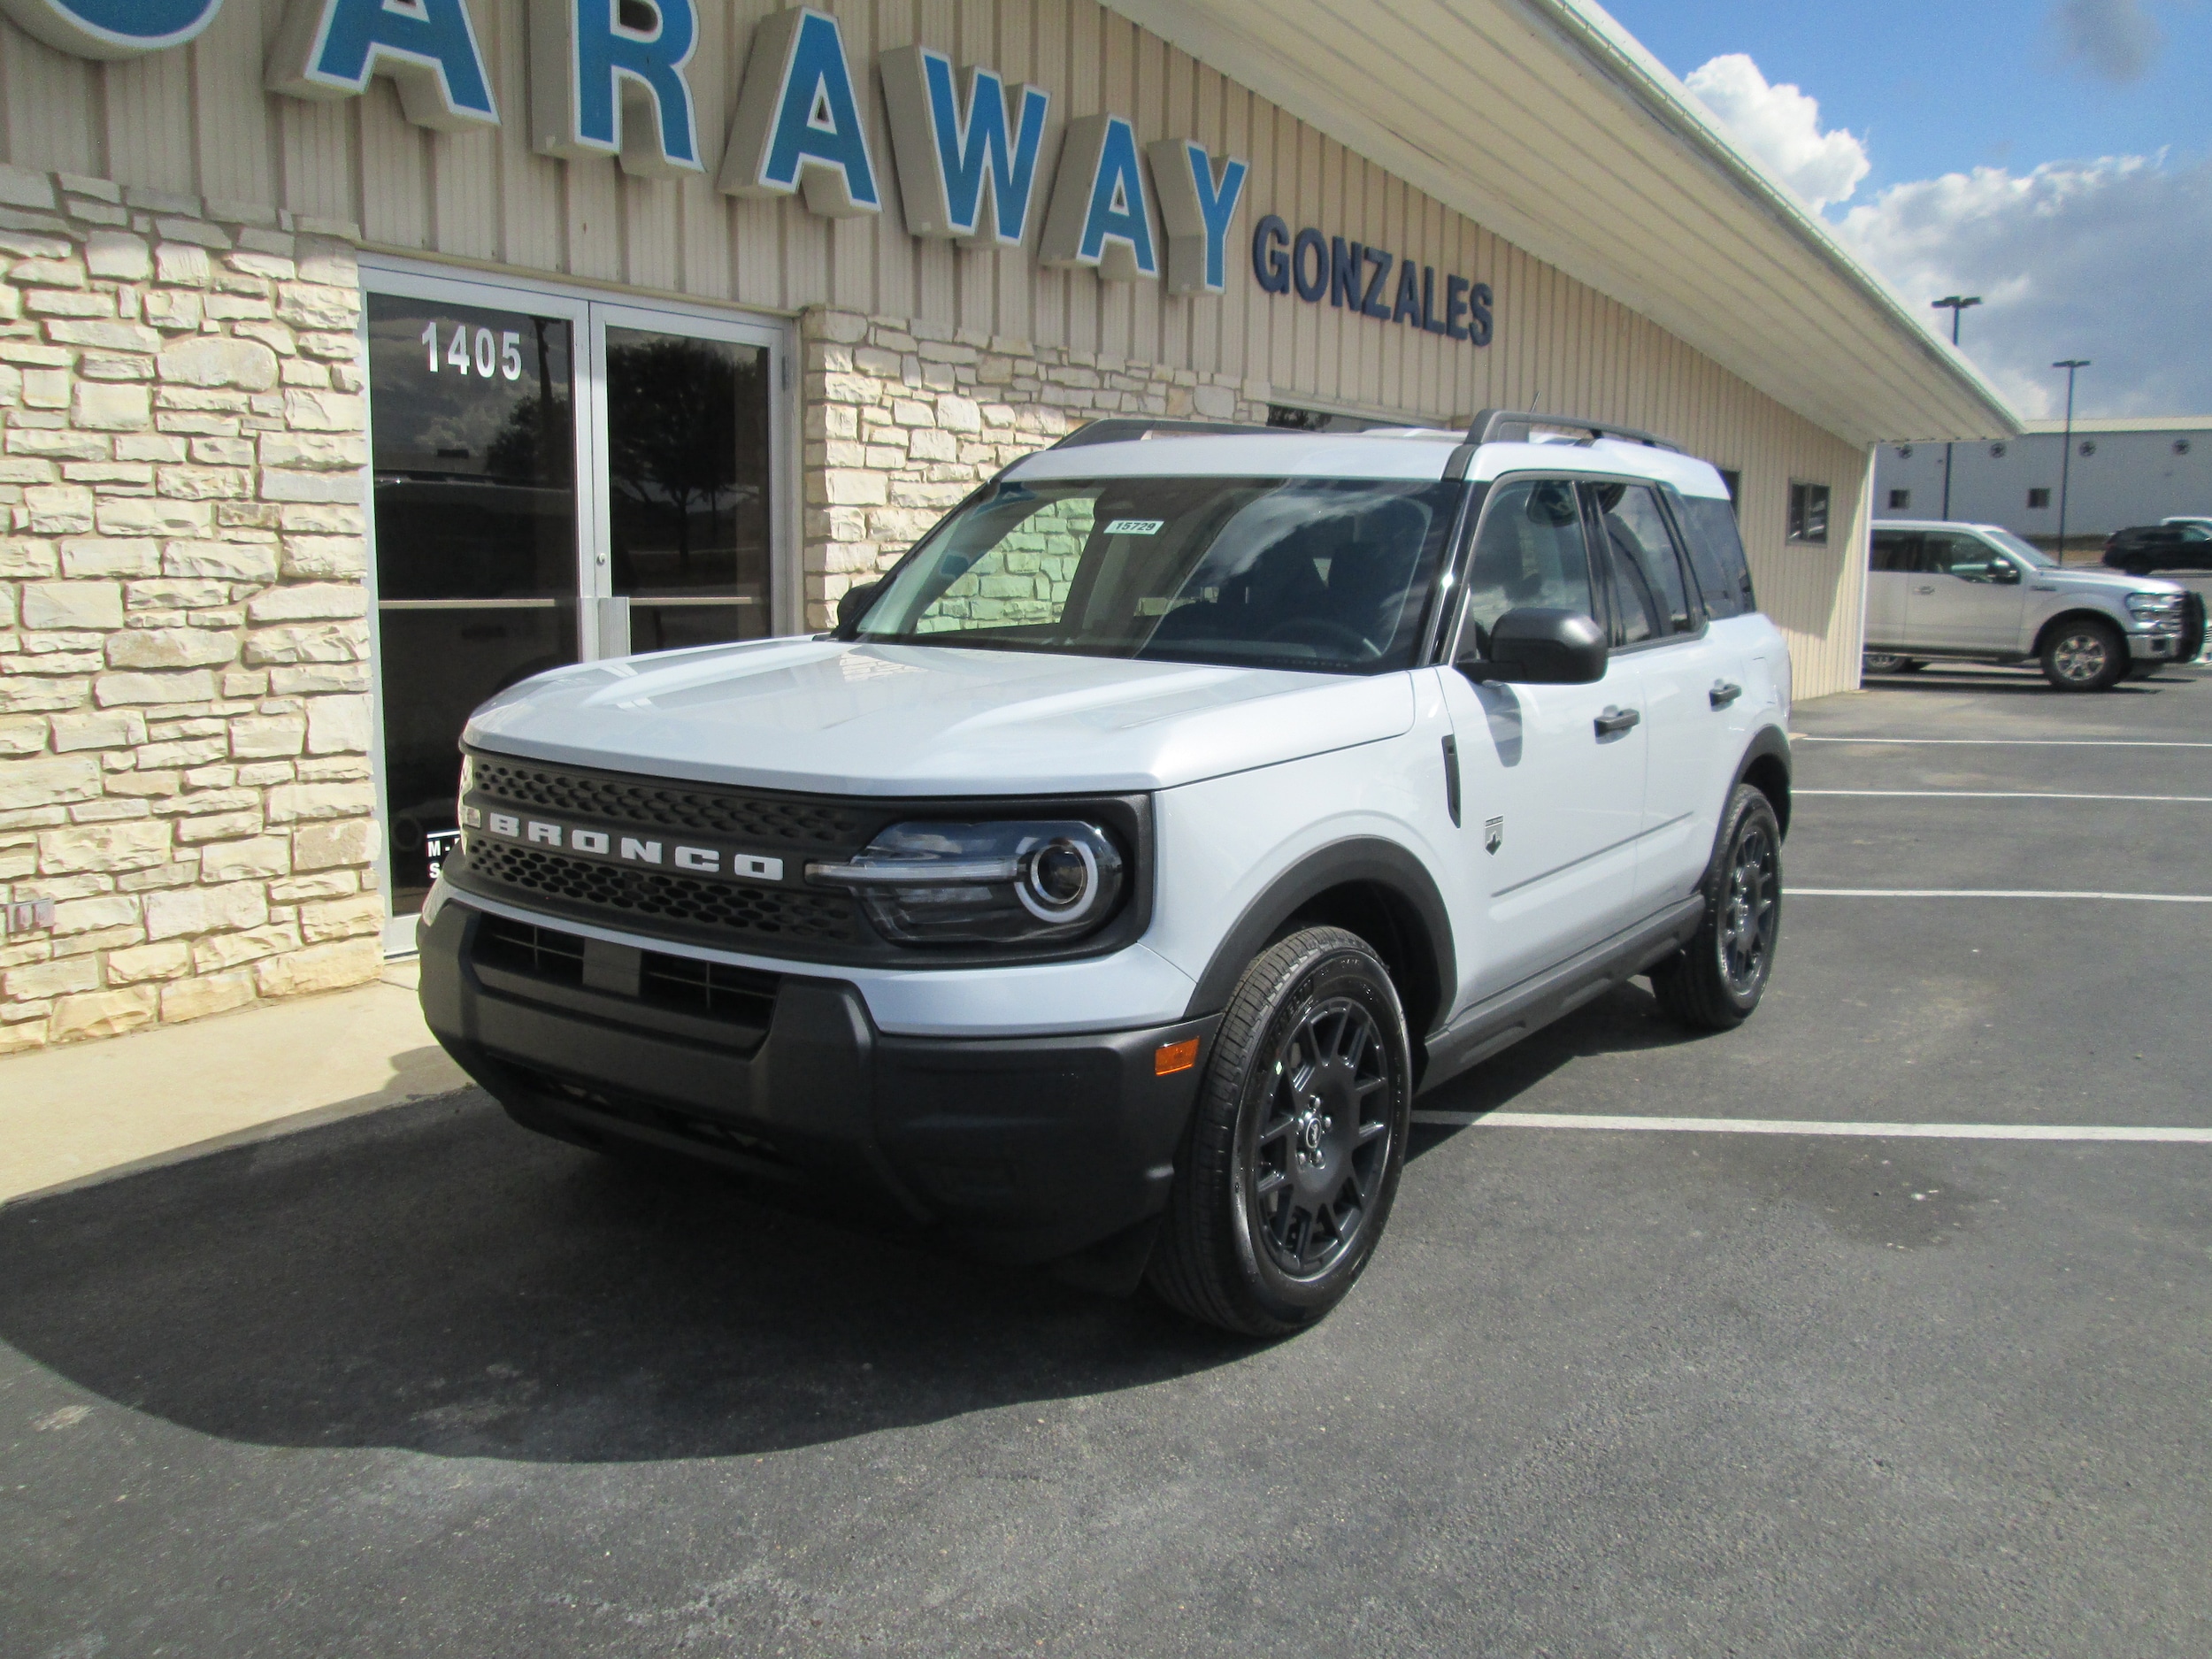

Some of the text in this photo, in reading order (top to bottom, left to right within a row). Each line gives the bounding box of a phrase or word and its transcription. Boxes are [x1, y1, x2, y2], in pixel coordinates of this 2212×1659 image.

[0, 0, 1249, 296] ARAWAY
[1252, 214, 1494, 347] GONZALES
[422, 321, 522, 380] 1405
[1115, 522, 1156, 531] 15729
[489, 812, 784, 881] BRONCO
